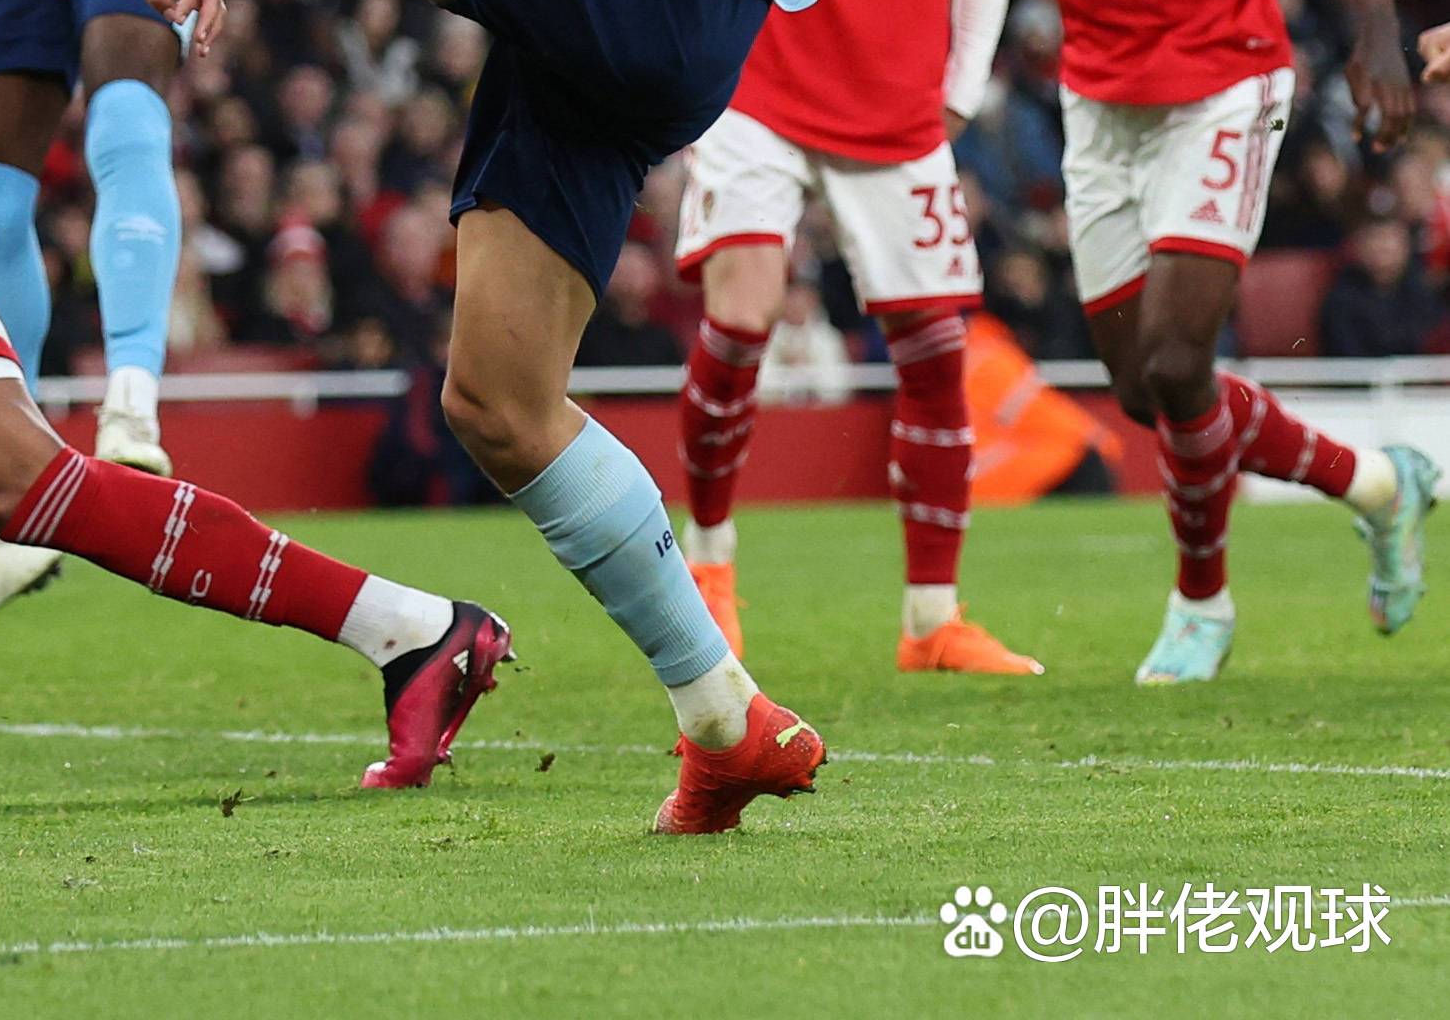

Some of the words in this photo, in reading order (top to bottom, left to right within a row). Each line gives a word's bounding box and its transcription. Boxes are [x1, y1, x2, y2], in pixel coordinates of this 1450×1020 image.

[1201, 130, 1241, 190] 5
[911, 185, 970, 248] 35
[655, 530, 673, 558] 18
